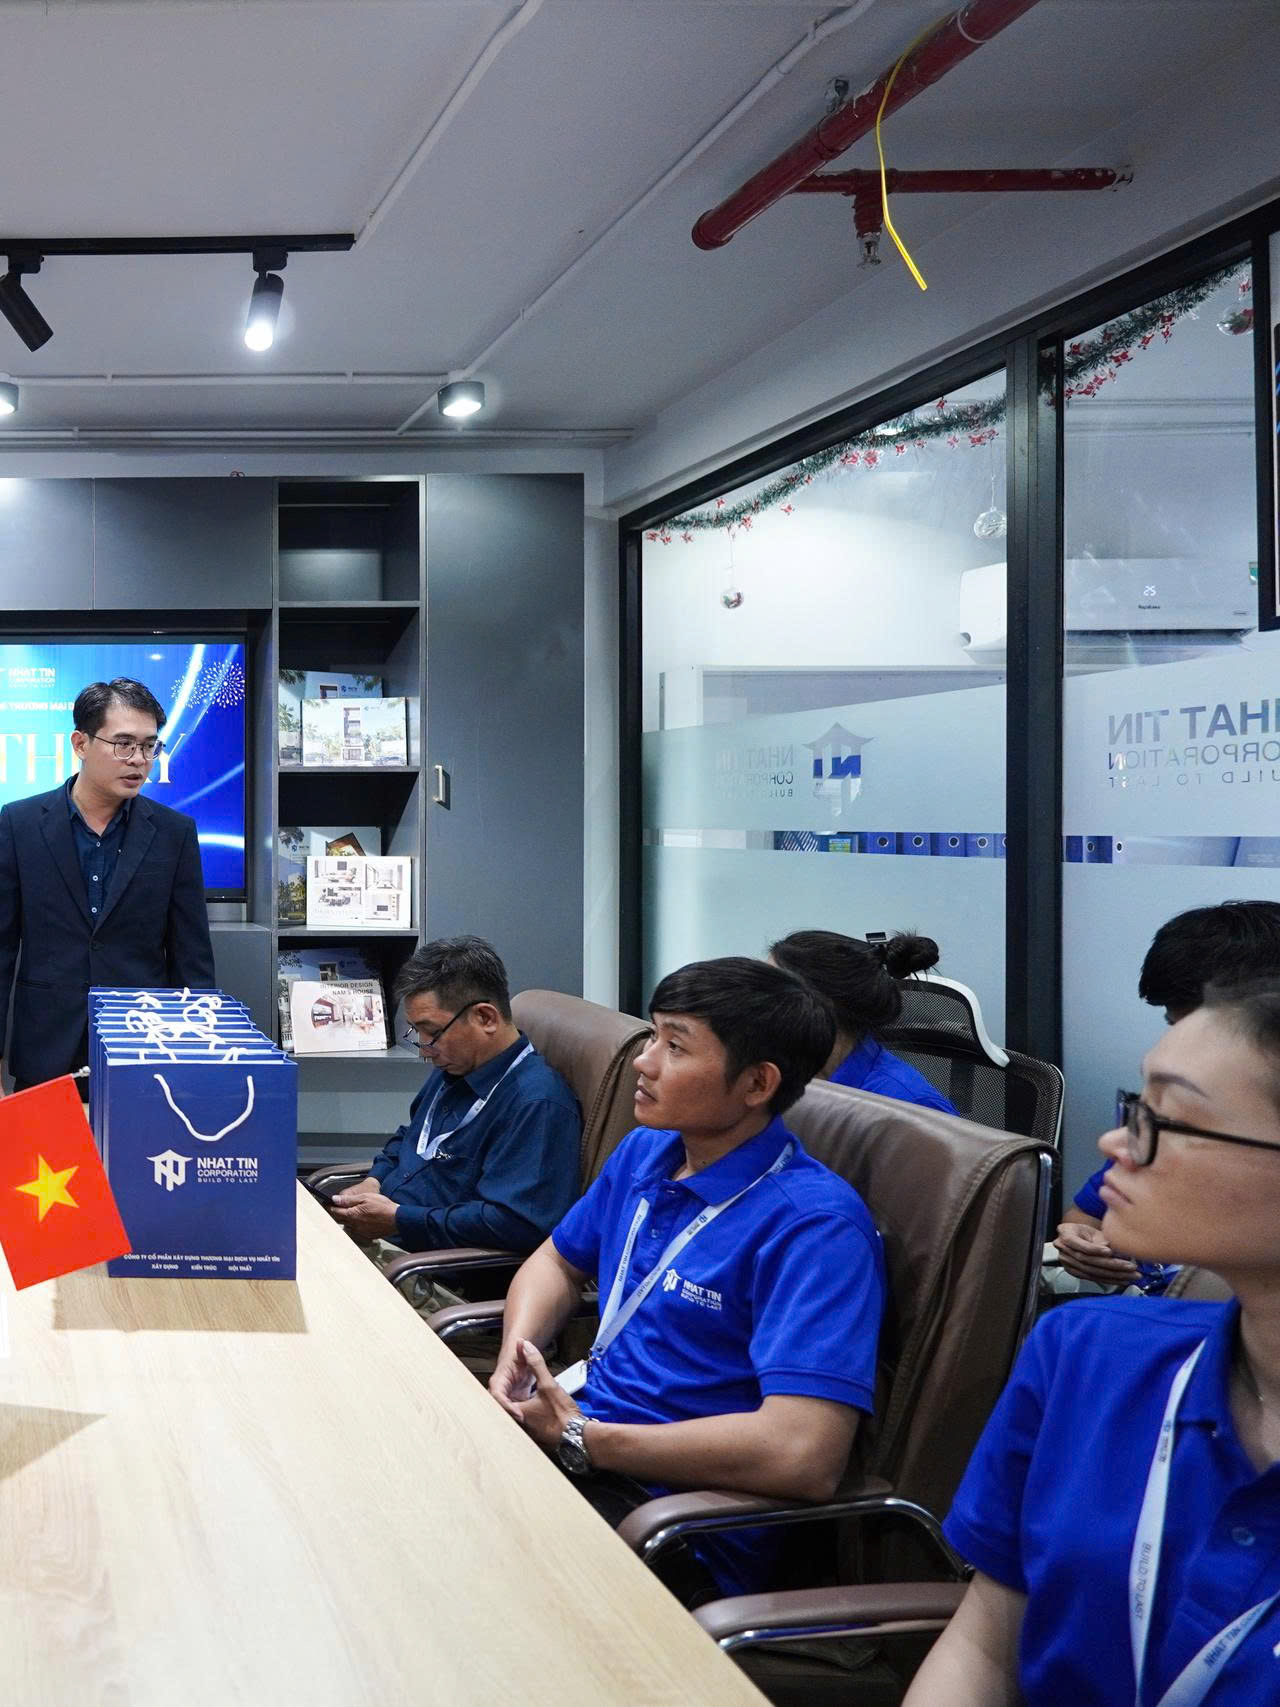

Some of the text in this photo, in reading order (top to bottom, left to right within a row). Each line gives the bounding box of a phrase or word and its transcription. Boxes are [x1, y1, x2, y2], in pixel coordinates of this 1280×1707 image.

[37, 668, 56, 677] TIN
[197, 1157, 258, 1169] NHAT TIN
[705, 1288, 722, 1301] TIN
[1203, 1639, 1227, 1668] NHAT
